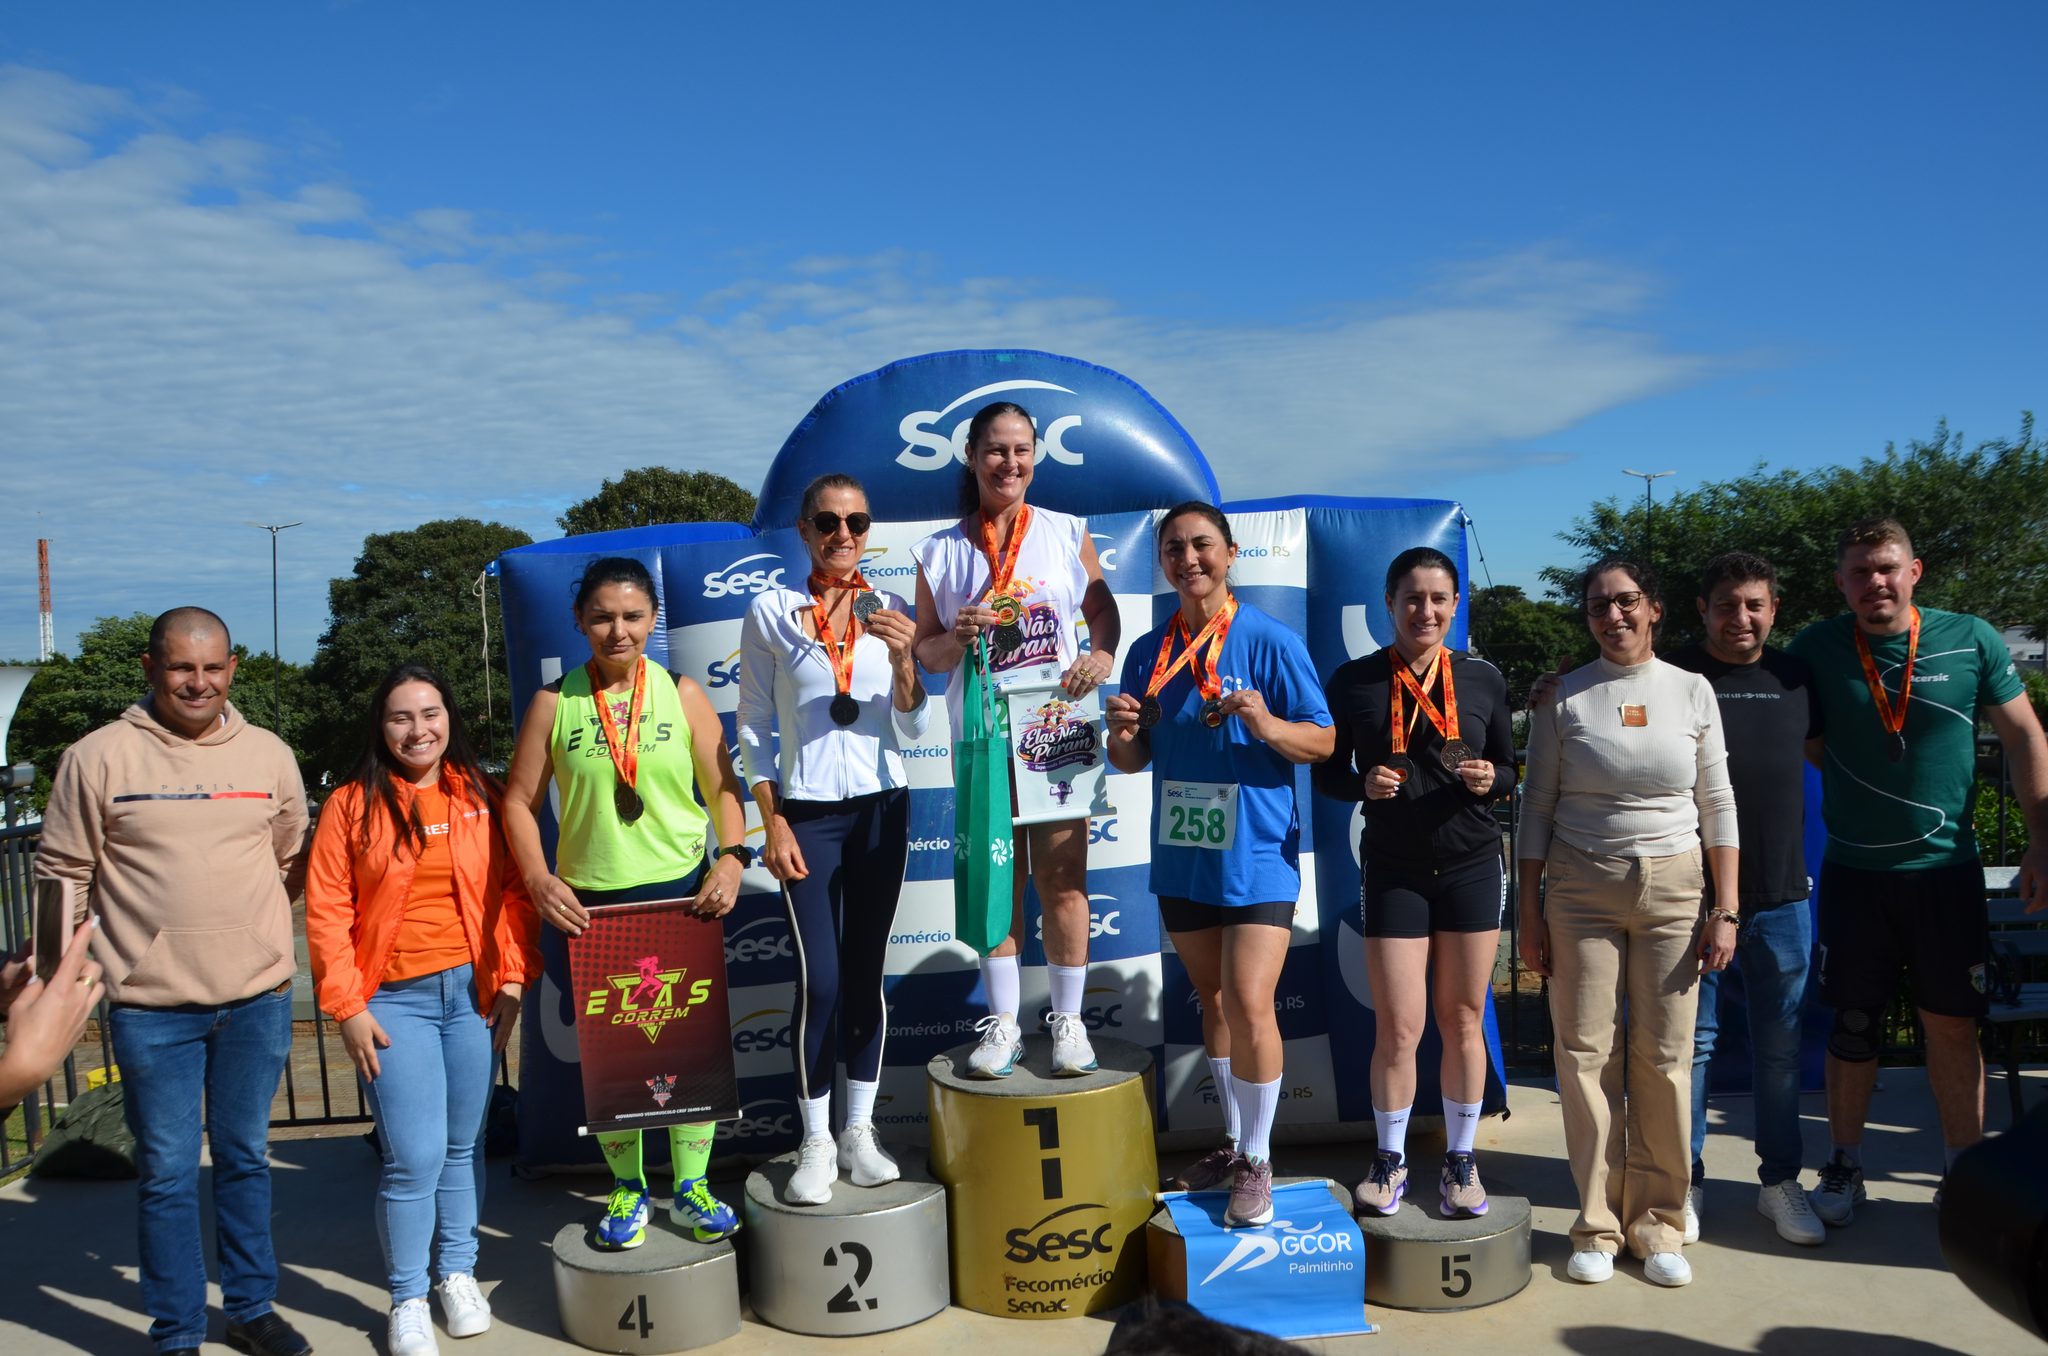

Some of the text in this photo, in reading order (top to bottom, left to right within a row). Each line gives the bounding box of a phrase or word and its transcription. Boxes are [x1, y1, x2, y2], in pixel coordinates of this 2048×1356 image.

[1272, 546, 1290, 557] RS
[702, 567, 787, 599] Sesc
[1169, 805, 1226, 844] 258
[889, 930, 951, 945] omércio
[585, 979, 713, 1015] ELAS
[611, 1006, 690, 1025] CORREM
[1023, 1107, 1060, 1200] 1
[1004, 1223, 1113, 1264] Sesc
[1004, 1270, 1114, 1293] Fecomércio
[1289, 1260, 1354, 1275] Palmitinho
[1441, 1253, 1473, 1299] 5
[617, 1294, 654, 1339] 4
[1007, 1297, 1070, 1314] Senac
